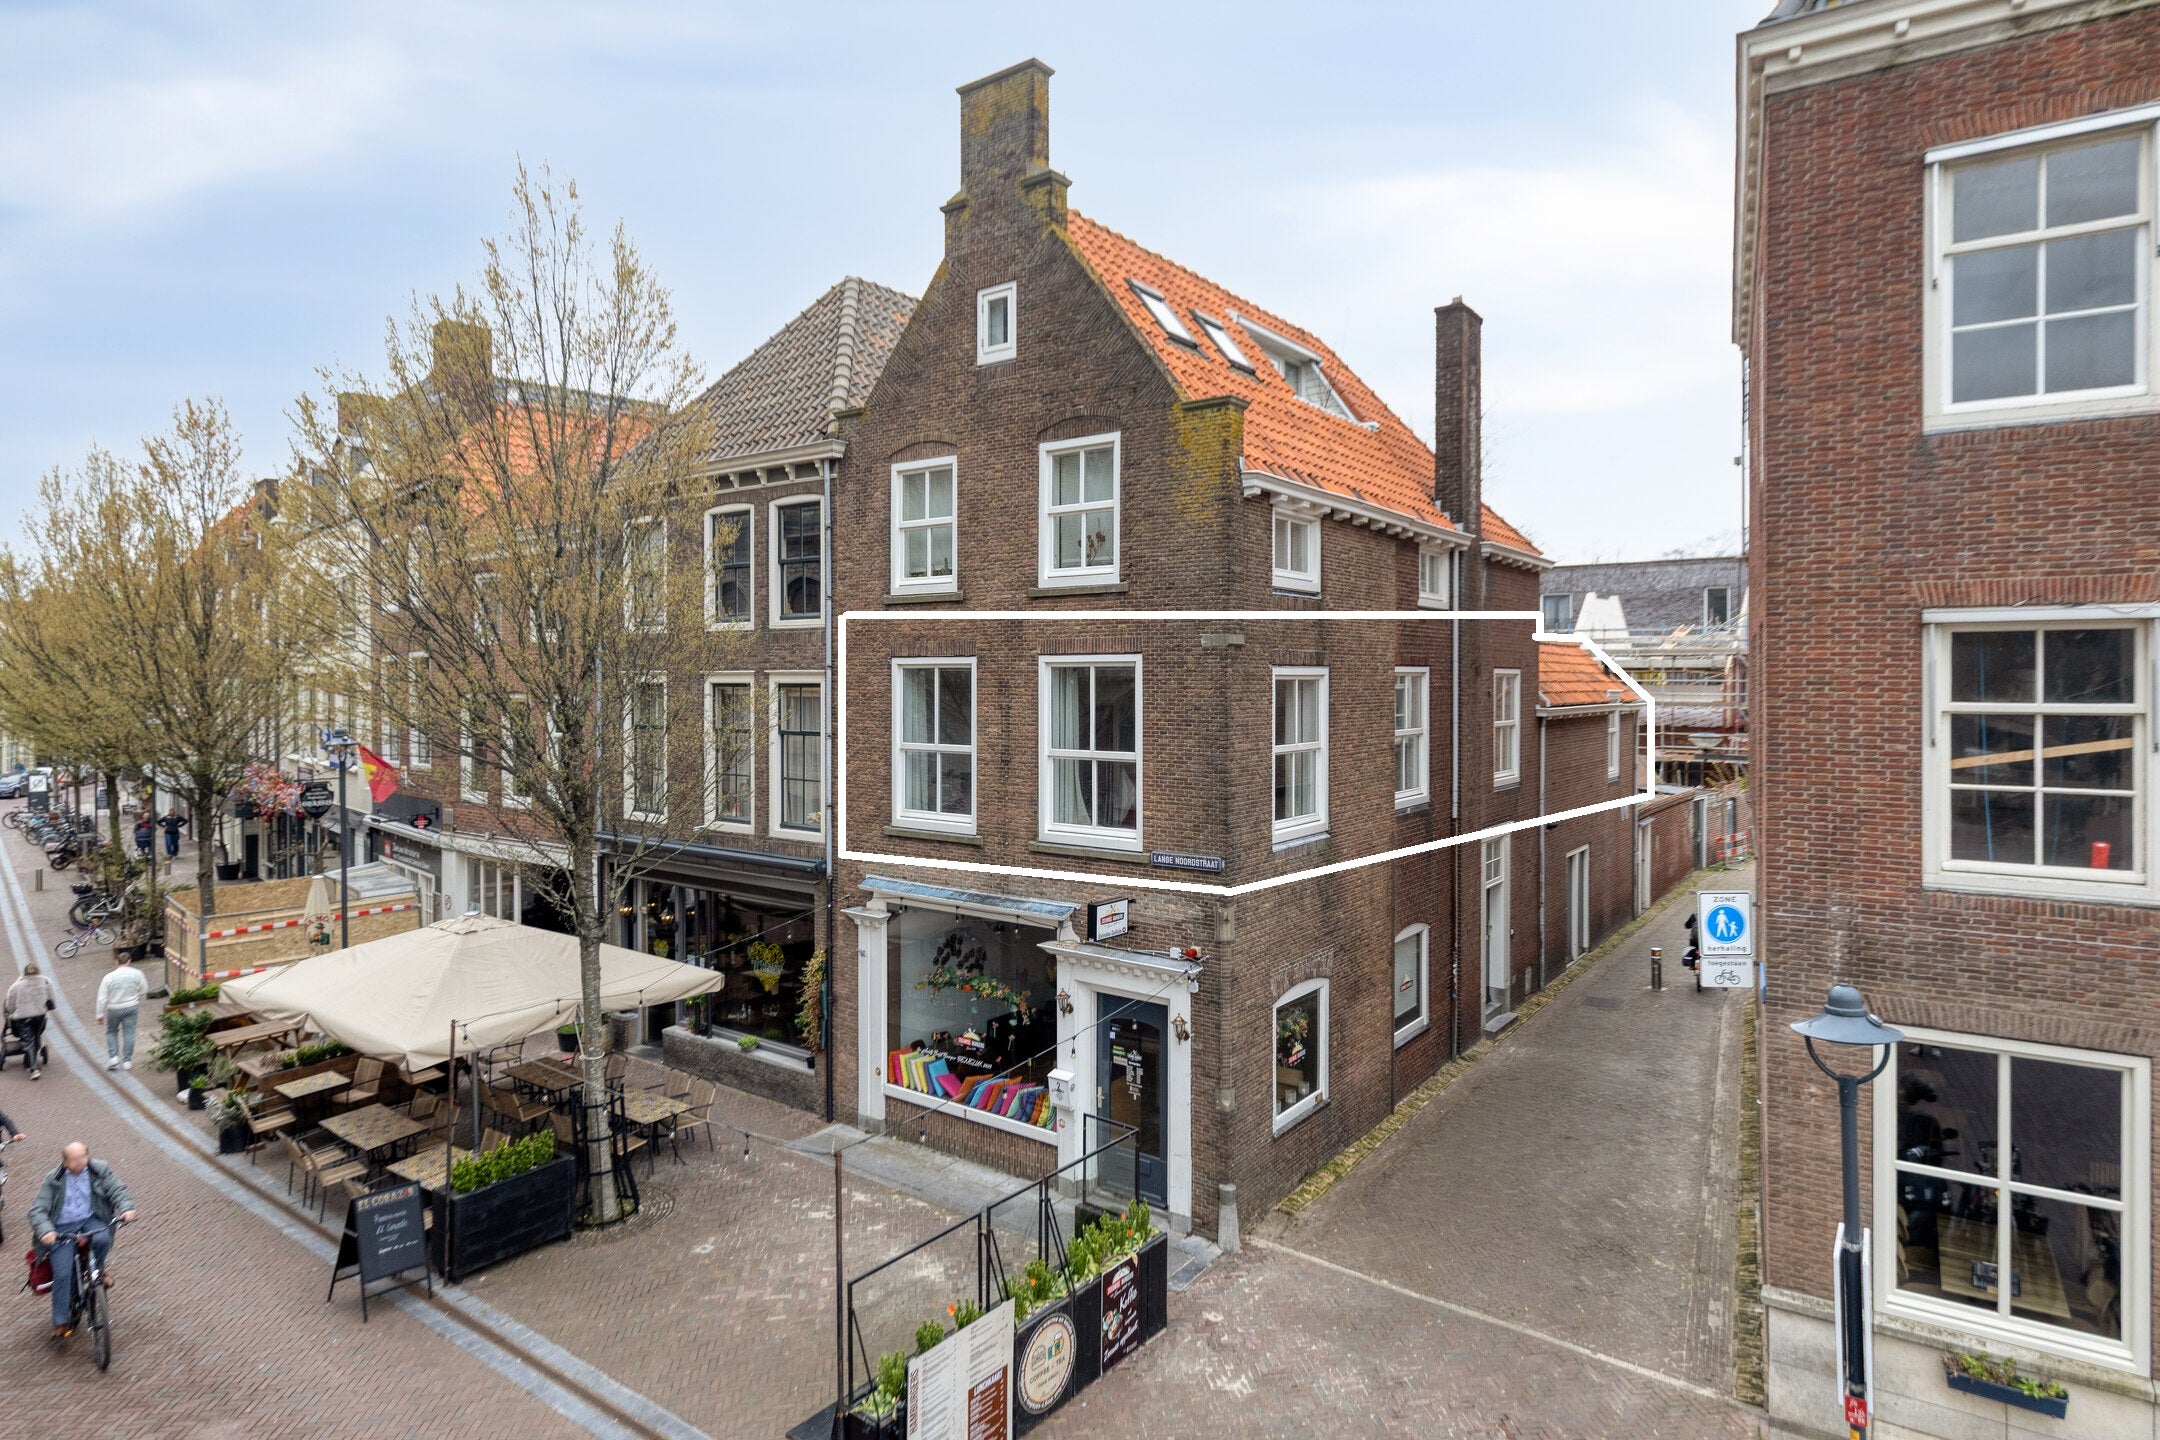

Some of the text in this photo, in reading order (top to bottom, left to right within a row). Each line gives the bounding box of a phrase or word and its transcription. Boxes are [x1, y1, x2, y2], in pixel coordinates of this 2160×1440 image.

[1153, 854, 1219, 869] LANGE NOORDSTRAAT
[1029, 1367, 1050, 1385] COFFEE
[1056, 1356, 1066, 1367] TEA
[909, 1368, 919, 1436] HAMBURGERS
